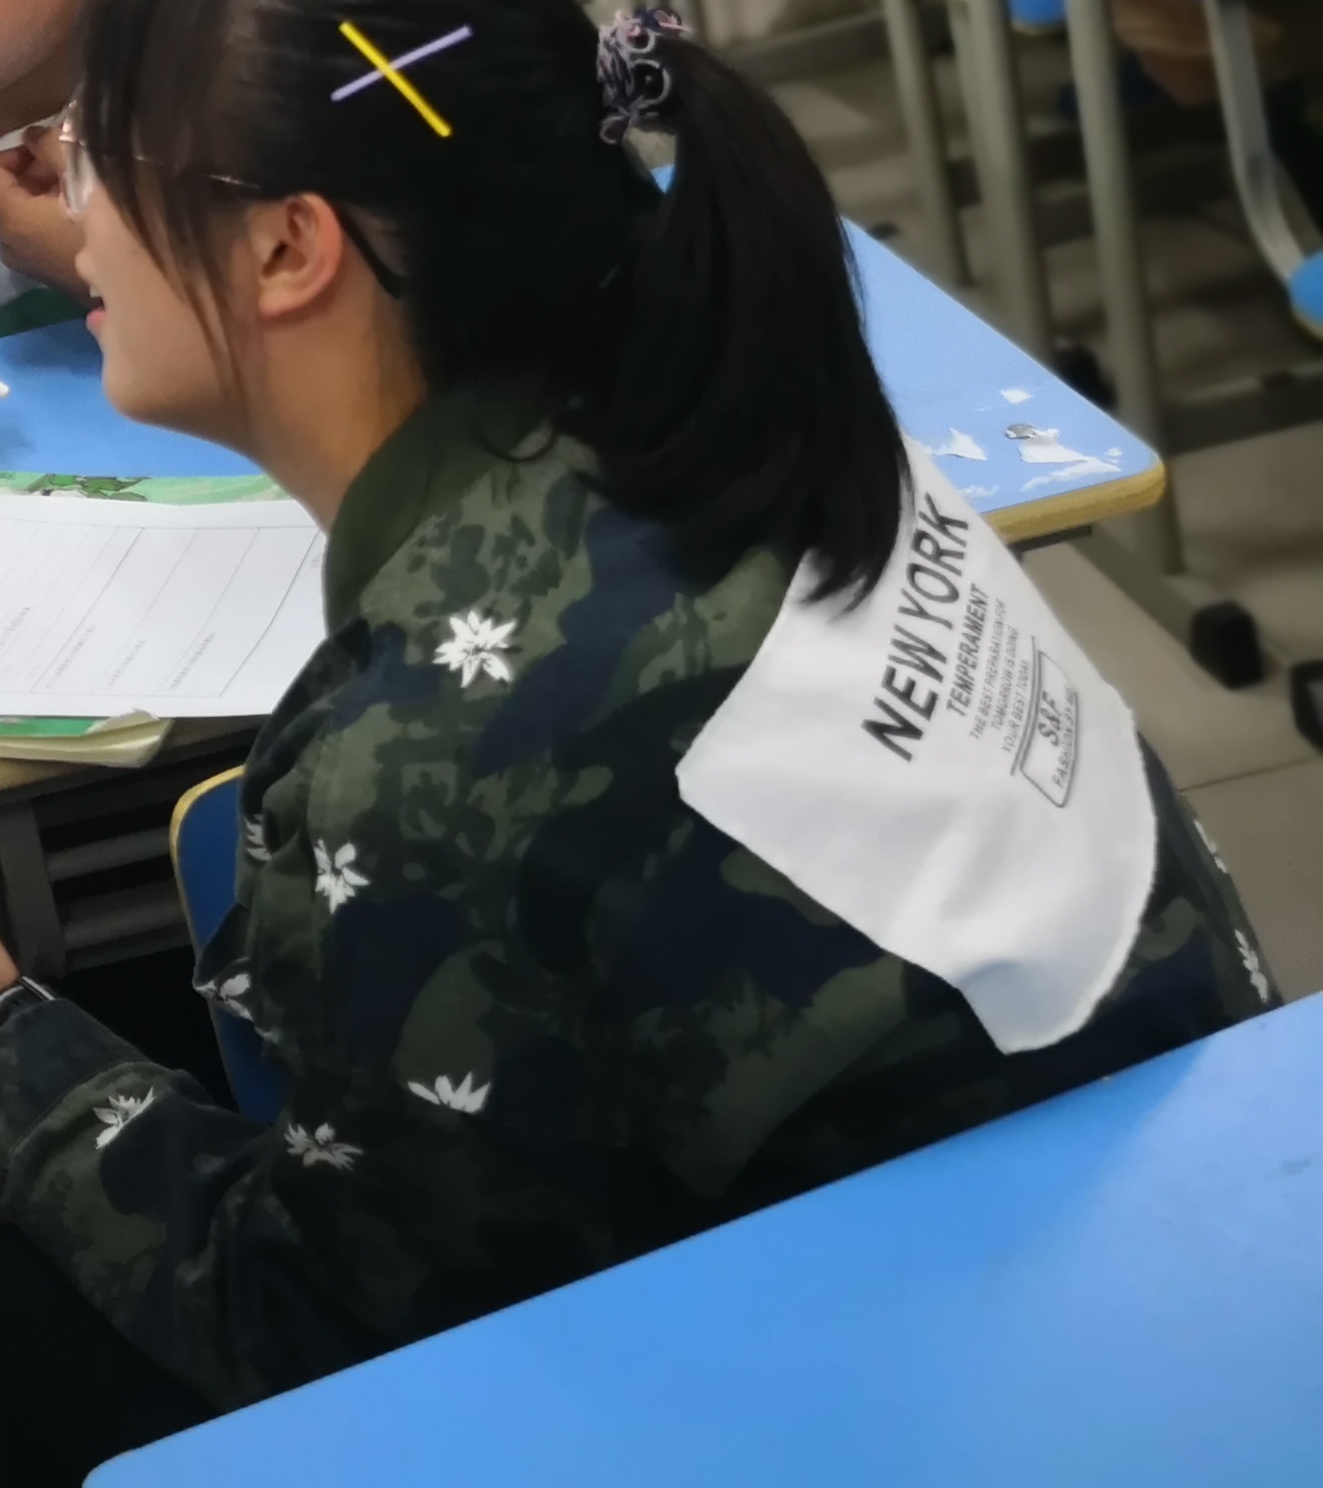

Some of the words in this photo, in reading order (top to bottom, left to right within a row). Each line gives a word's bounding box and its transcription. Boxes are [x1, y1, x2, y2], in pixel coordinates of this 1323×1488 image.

[898, 491, 969, 630] YORK
[946, 583, 988, 717] TEMPERAMENT
[861, 623, 947, 762] NEW
[977, 685, 993, 717] BEST
[991, 667, 1013, 730] TOMORROW
[1001, 720, 1019, 753] YOUR
[1011, 690, 1025, 722] BEST
[1037, 689, 1062, 747] S&F
[969, 715, 986, 740] THE
